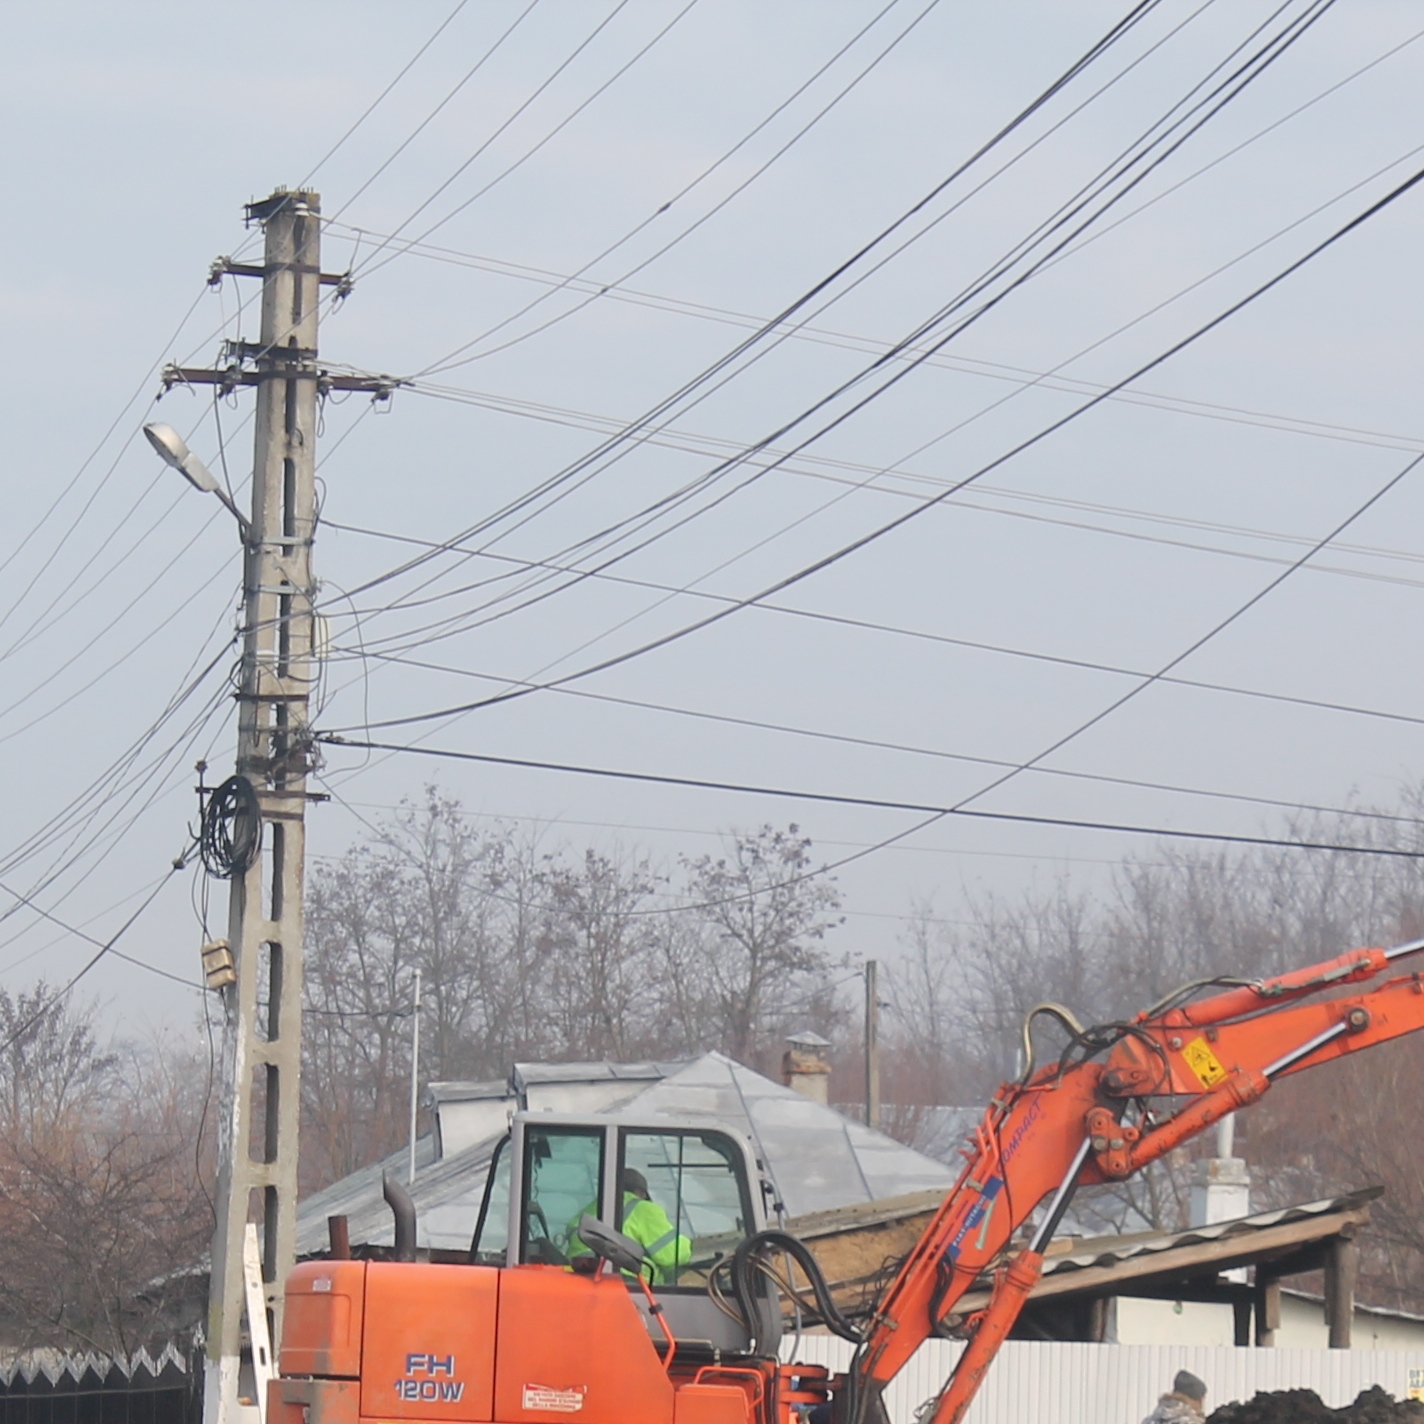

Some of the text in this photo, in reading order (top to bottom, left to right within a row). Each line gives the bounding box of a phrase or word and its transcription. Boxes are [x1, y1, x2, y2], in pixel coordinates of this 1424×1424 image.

[952, 1194, 987, 1247] FIAT-HITACHI
[406, 1353, 455, 1377] FH
[394, 1379, 464, 1403] 120W
